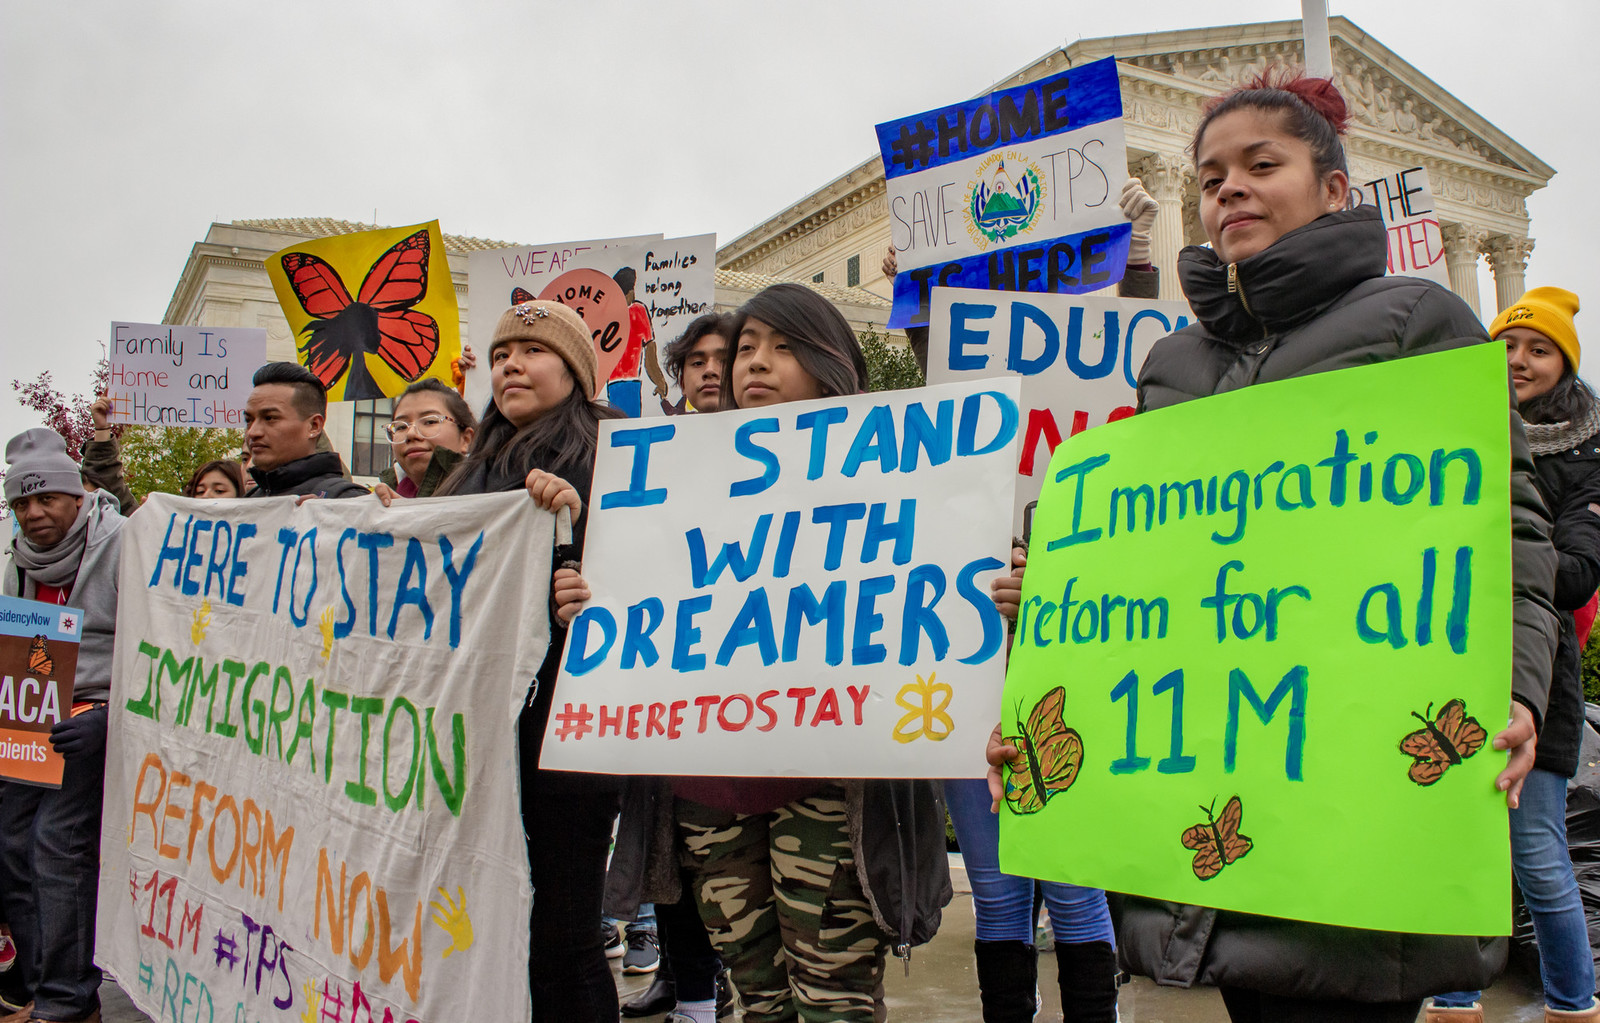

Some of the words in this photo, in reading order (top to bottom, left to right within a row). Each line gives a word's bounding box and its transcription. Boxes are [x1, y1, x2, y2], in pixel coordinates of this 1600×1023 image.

[891, 76, 1070, 170] #HOME
[975, 151, 1004, 178] SALVADOR
[1006, 150, 1017, 160] EN
[1018, 151, 1029, 163] LA
[892, 182, 958, 252] SAVE
[1041, 138, 1109, 221] TPS
[967, 179, 977, 190] EL
[1363, 166, 1433, 222] THE
[1022, 203, 1046, 235] CENTRAL
[645, 276, 682, 297] belong
[987, 231, 1111, 294] HERE
[649, 297, 707, 328] together
[1505, 312, 1534, 325] here
[115, 326, 184, 367] Family
[197, 332, 228, 359] Is
[948, 301, 1201, 389] EDUC
[111, 363, 169, 387] Home
[188, 366, 229, 390] and
[110, 391, 246, 425] #HomeIsHer
[600, 424, 676, 511] I
[729, 390, 1019, 499] STAND
[20, 479, 47, 496] here
[1046, 428, 1483, 552] Immigration
[685, 498, 917, 589] WITH
[148, 512, 257, 607] HERE
[272, 525, 319, 628] TO
[333, 526, 485, 652] STAY
[1018, 576, 1170, 648] reform
[1200, 559, 1312, 644] for
[1356, 545, 1474, 655] all
[564, 556, 1006, 677] DREAMERS
[125, 638, 466, 818] IMMIGRATION
[554, 684, 871, 742] #HERETOSTAY
[130, 752, 295, 915] REFORM
[313, 846, 424, 1005] NOW
[130, 867, 204, 956] #11M
[213, 911, 295, 1011] #TPS
